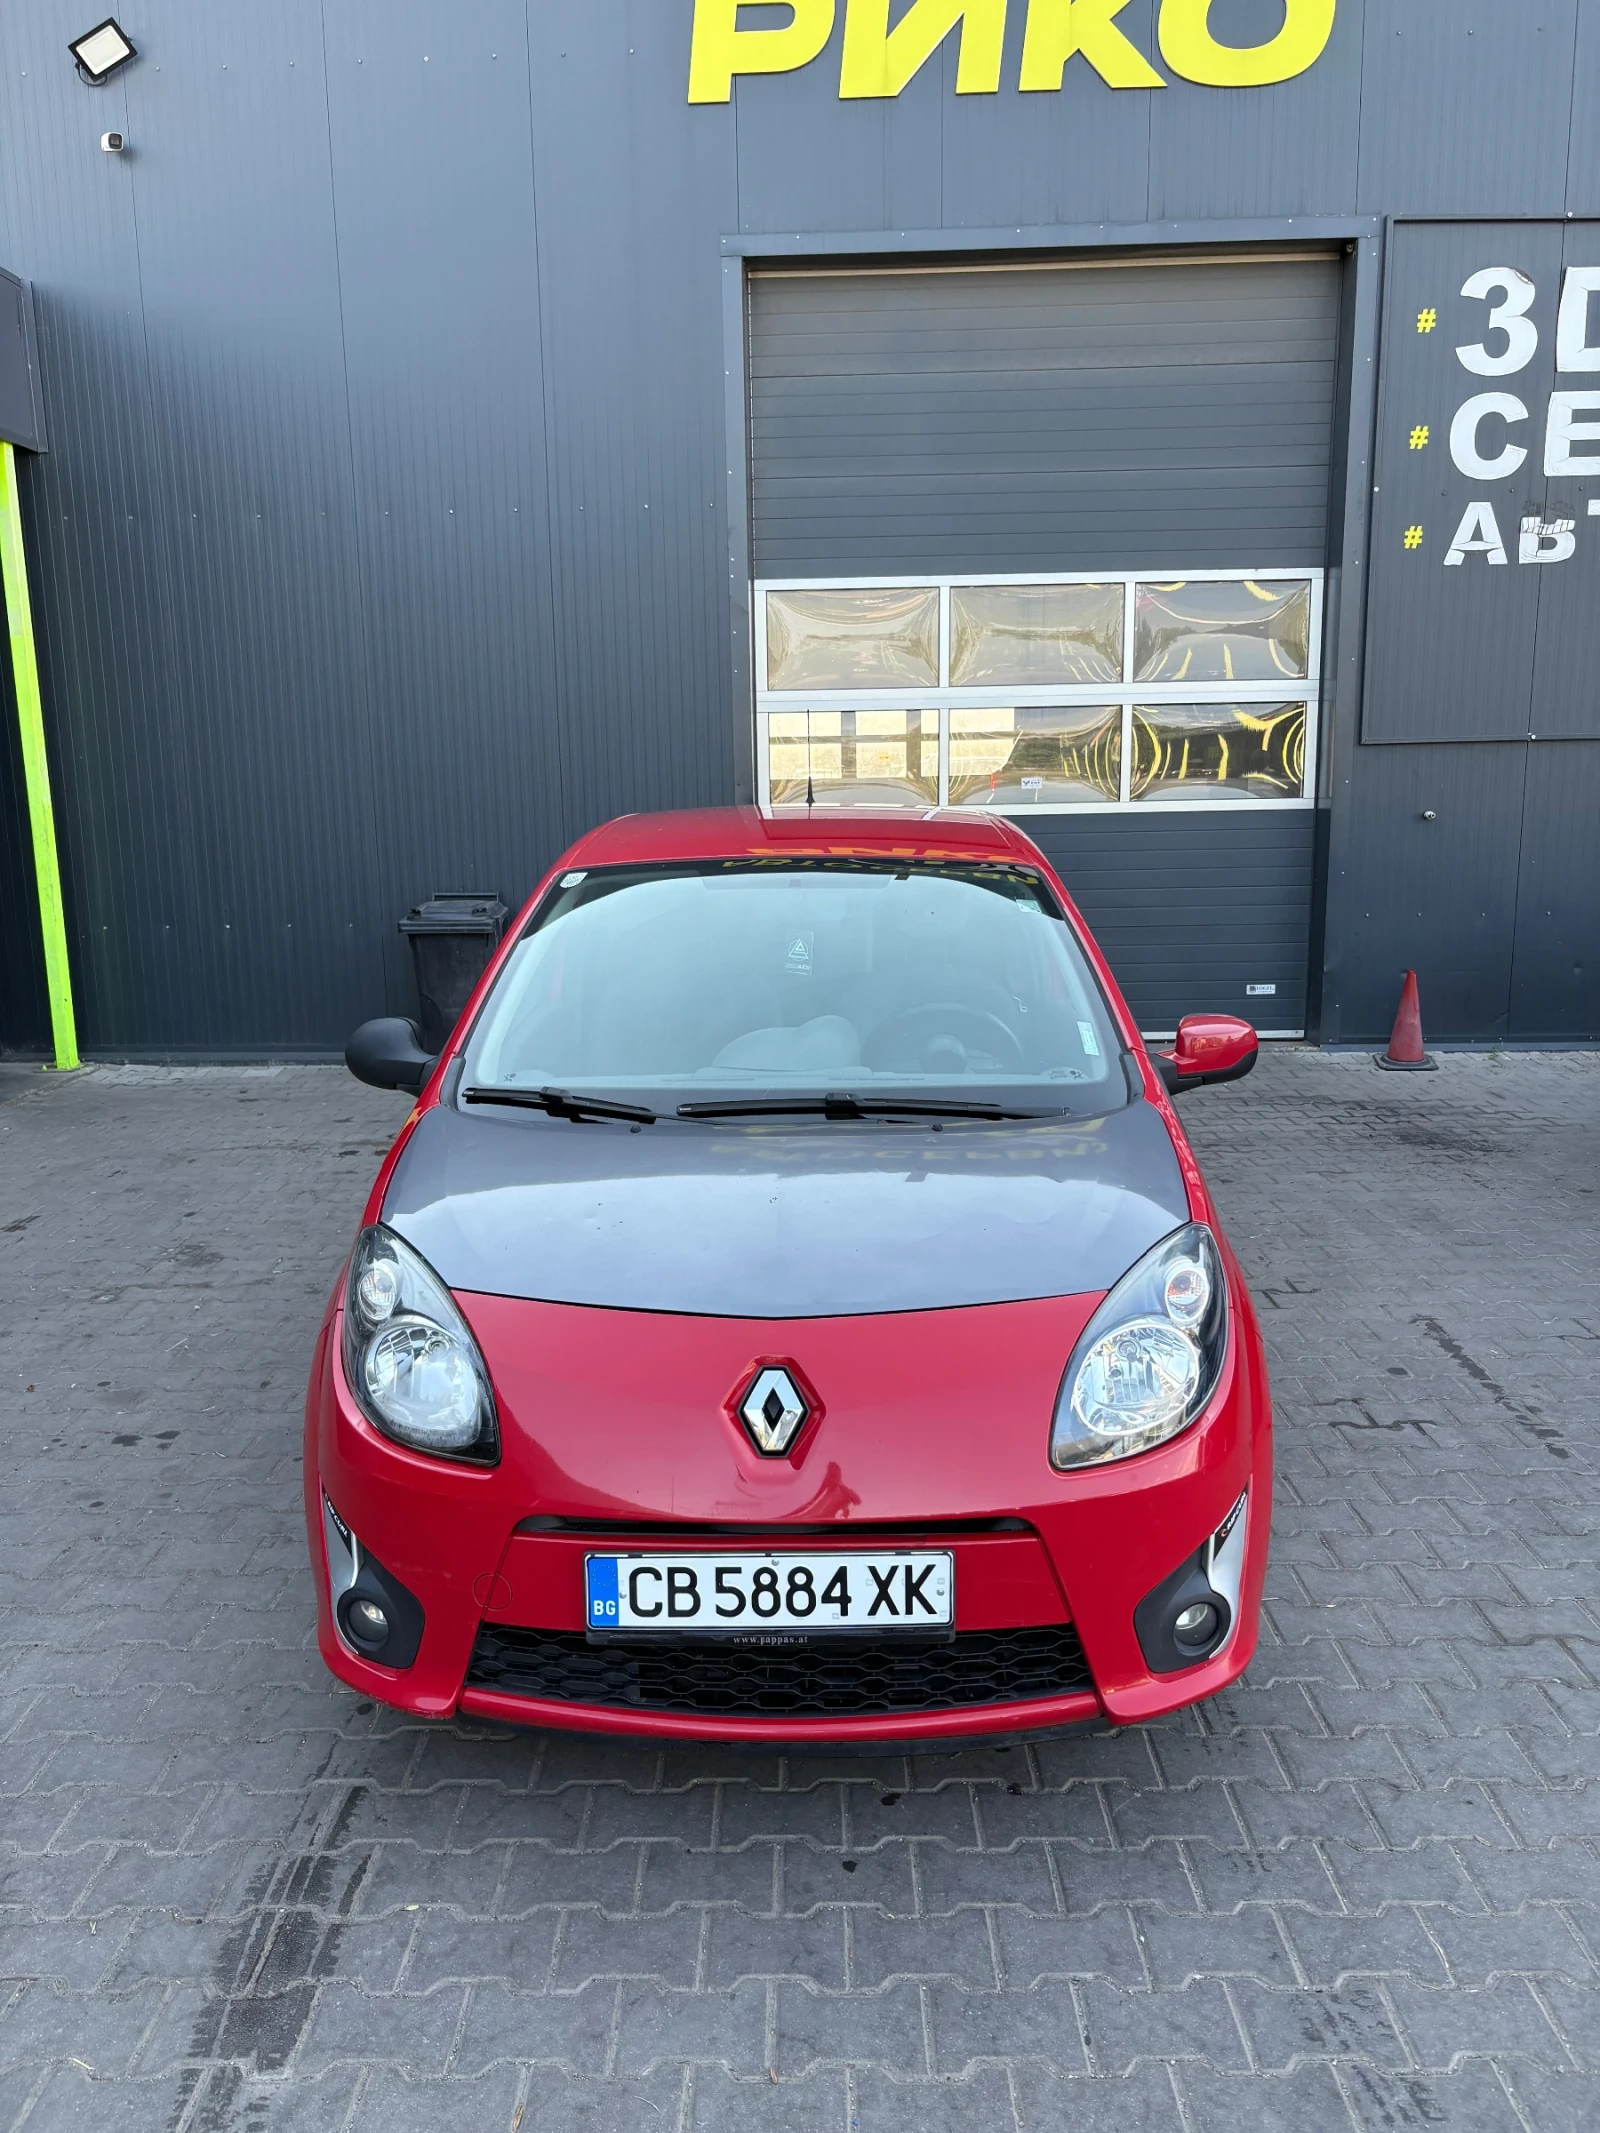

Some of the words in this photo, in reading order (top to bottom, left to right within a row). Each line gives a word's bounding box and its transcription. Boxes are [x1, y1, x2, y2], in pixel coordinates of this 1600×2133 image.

[1443, 500, 1600, 566] АВ
[593, 1600, 616, 1616] BG
[628, 1566, 701, 1618] CB
[714, 1565, 852, 1618] 5884
[867, 1564, 938, 1616] XK
[733, 1635, 808, 1646] www.pappas.at
